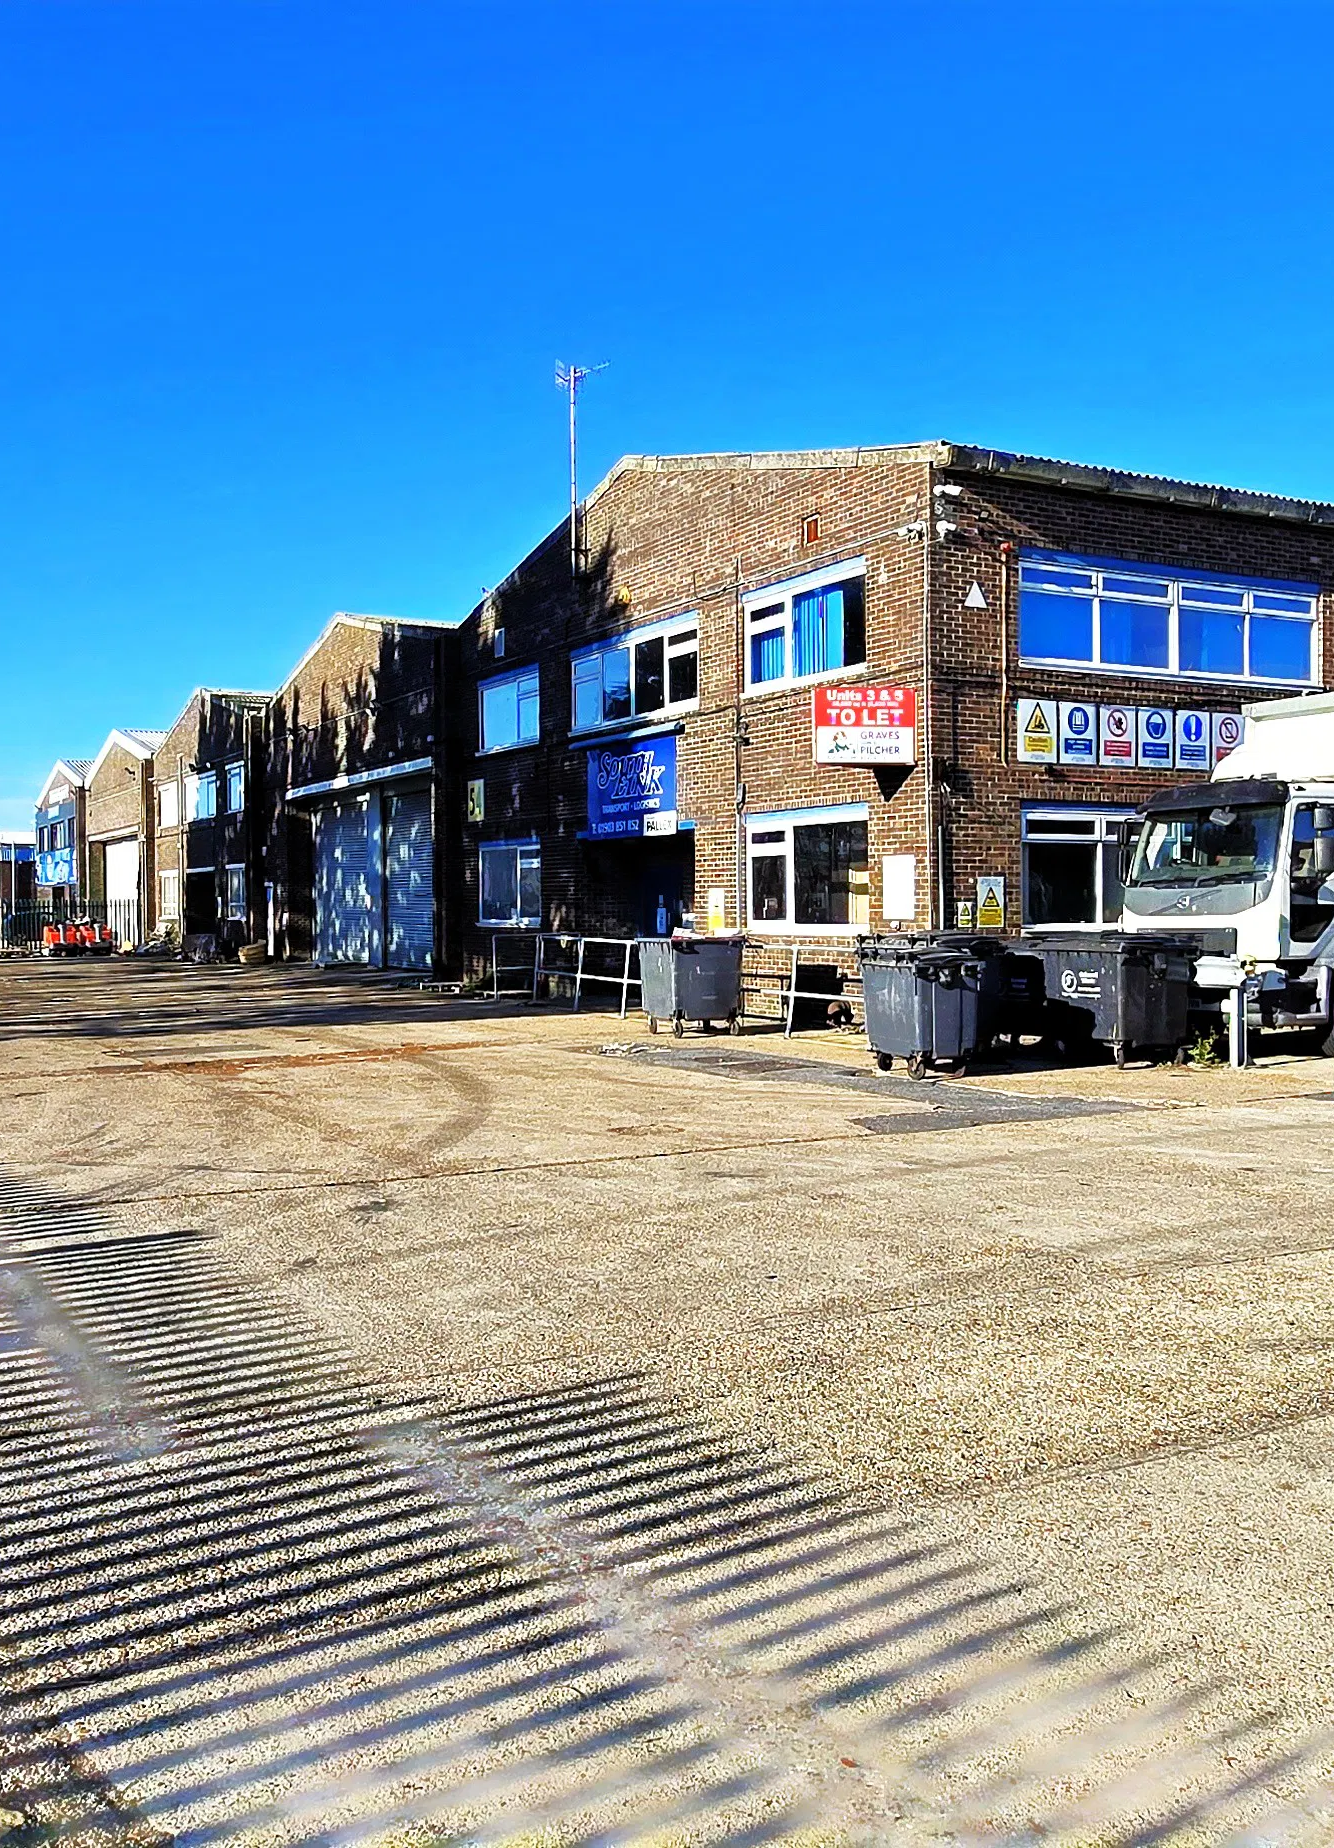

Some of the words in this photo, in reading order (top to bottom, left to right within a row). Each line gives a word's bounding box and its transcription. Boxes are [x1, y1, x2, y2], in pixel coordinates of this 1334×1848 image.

[826, 689, 862, 701] Units
[866, 689, 876, 701] 3
[879, 689, 891, 701] &
[894, 689, 904, 701] 5
[826, 708, 856, 726] TO
[862, 708, 904, 726] LET
[860, 730, 900, 740] GRAVES
[860, 746, 900, 755] PILCHER
